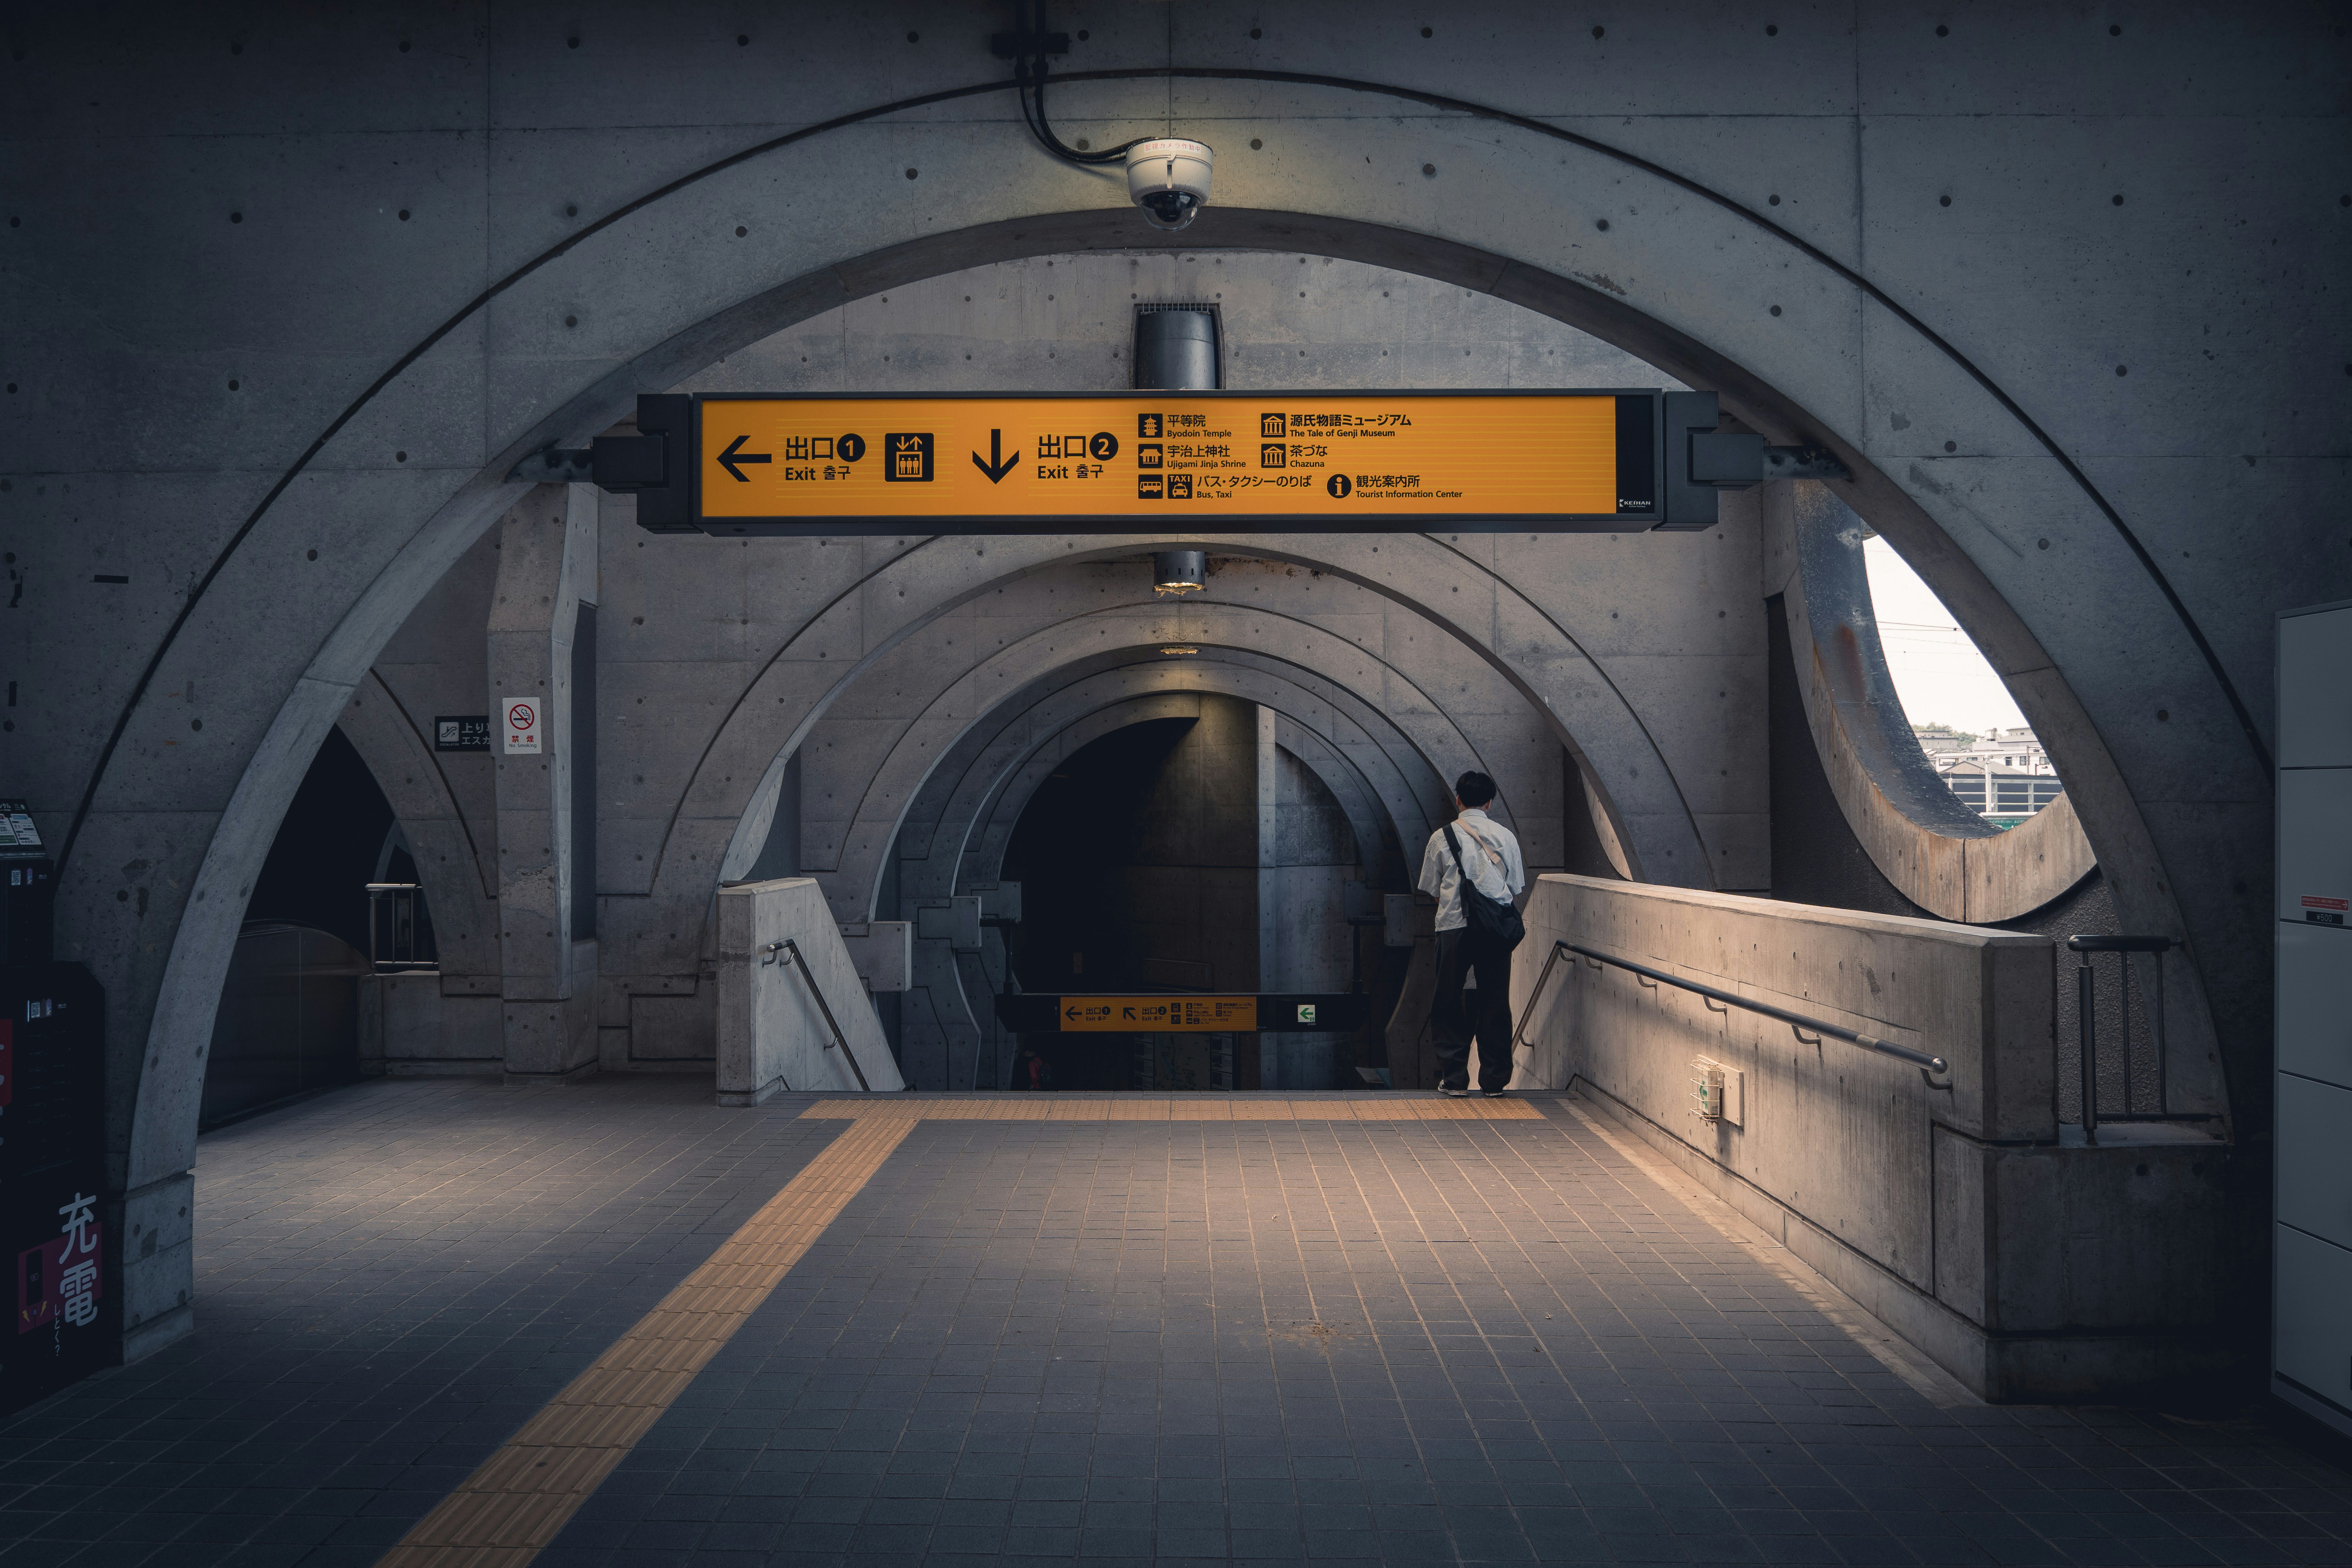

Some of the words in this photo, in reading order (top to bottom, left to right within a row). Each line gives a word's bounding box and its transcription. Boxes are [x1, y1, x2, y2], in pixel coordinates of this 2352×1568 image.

[1145, 143, 1200, 151] 監視カメラ作動中
[1168, 414, 1206, 427] 平等院
[1291, 414, 1412, 427] 源氏物語ミュージアム
[1168, 430, 1200, 439] Byodoin
[1202, 430, 1231, 438] Temple
[1337, 429, 1357, 439] Genji
[1168, 445, 1230, 458] 宇治上神社
[1290, 445, 1327, 457] 茶づな
[1168, 460, 1197, 469] Ujigami
[1200, 460, 1218, 469] Jinja
[786, 467, 815, 480] Exit
[823, 466, 851, 480] 출구
[1038, 465, 1068, 479] Exit
[1076, 464, 1103, 479] 출구
[1197, 475, 1312, 488] バス・タクシーのりば
[1356, 475, 1420, 488] 観光案内所
[2316, 913, 2332, 922] ¥500
[59, 1192, 97, 1326] 充電
